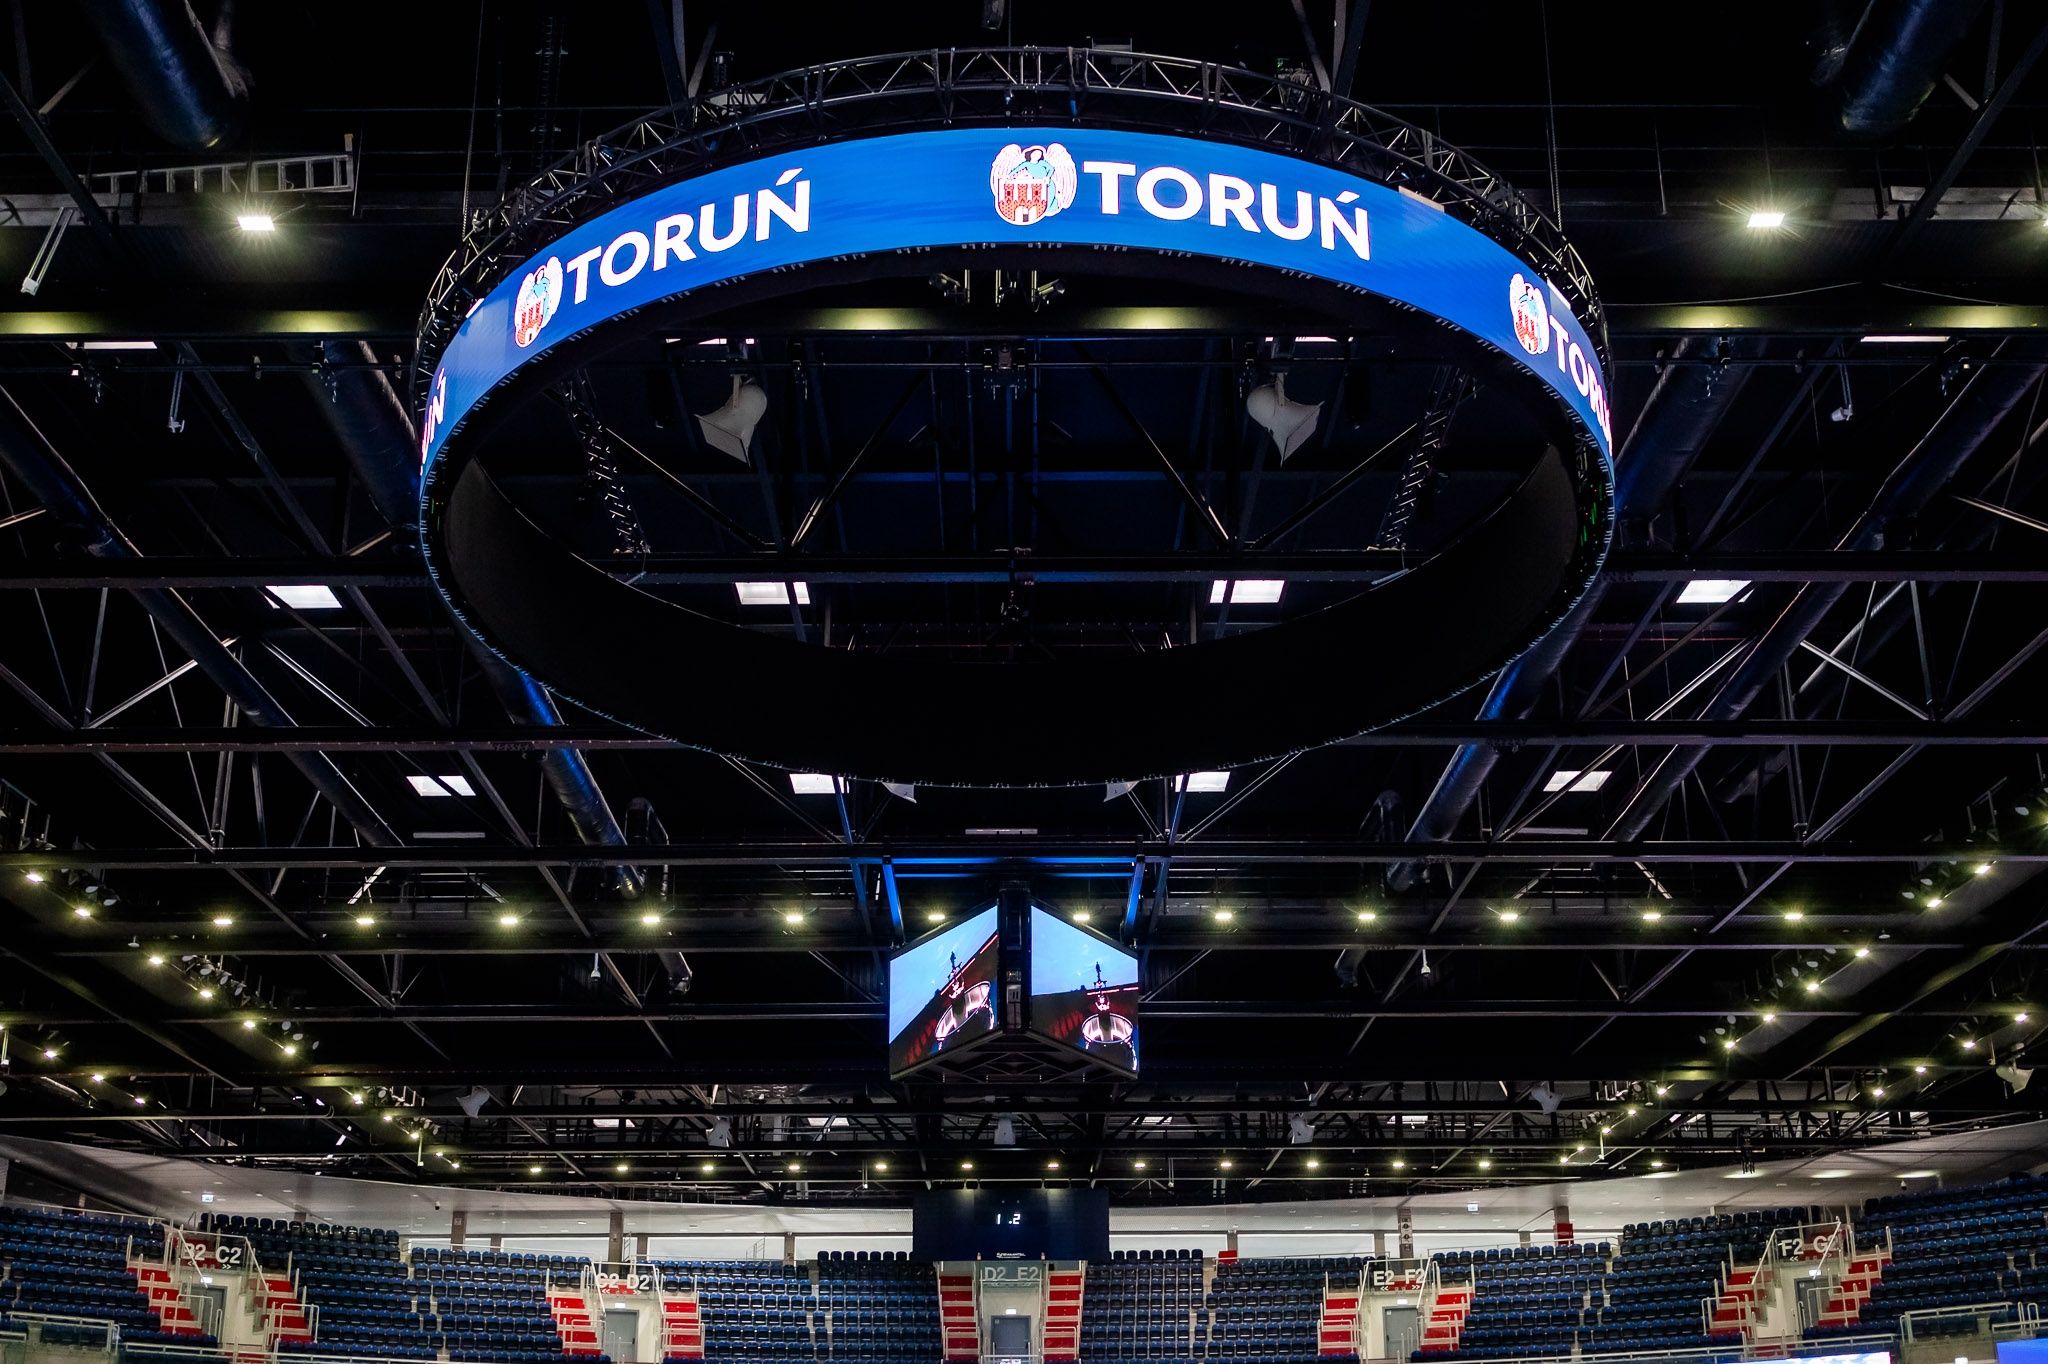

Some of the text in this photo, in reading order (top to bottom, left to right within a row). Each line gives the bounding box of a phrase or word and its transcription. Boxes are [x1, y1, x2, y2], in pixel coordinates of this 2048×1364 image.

[1084, 160, 1370, 260] TORUŃ
[567, 168, 811, 304] TORUŃ
[1549, 314, 1613, 457] TORU
[215, 1245, 242, 1264] C2
[1781, 1238, 1804, 1256] F2
[626, 1274, 650, 1290] D2
[984, 1266, 1039, 1280] D2 E2
[1373, 1268, 1425, 1286] E2 F2
